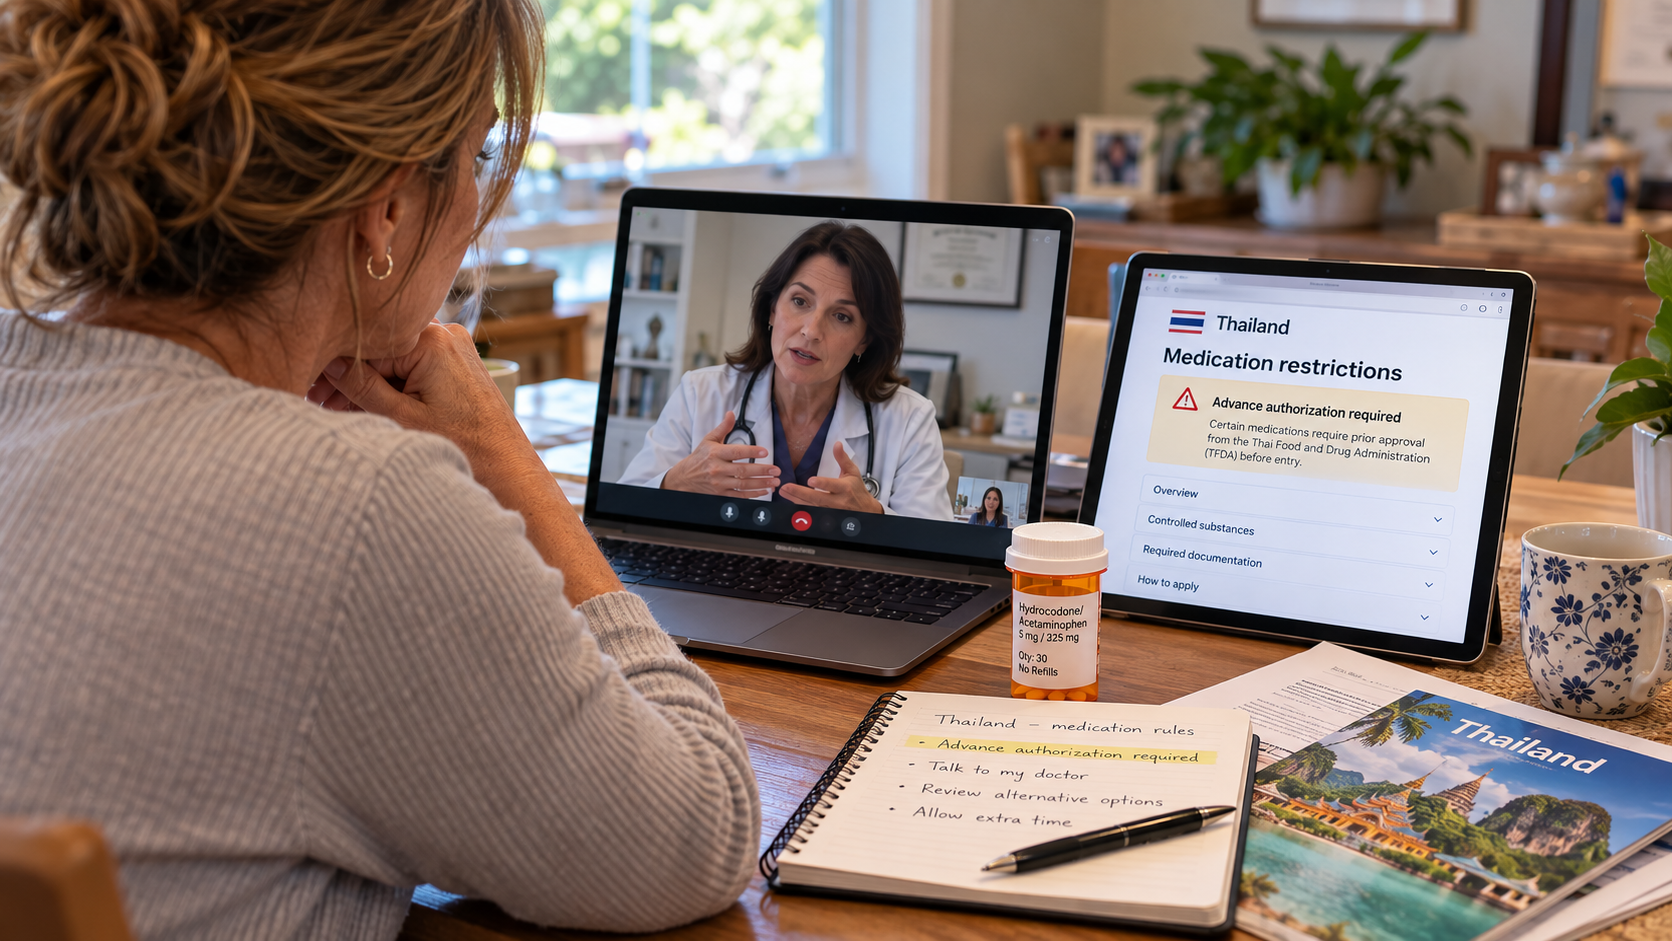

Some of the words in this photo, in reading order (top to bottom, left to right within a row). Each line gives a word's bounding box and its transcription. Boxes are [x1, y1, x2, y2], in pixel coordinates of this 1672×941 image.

[1216, 315, 1291, 336] Thailand
[1163, 348, 1274, 372] Medication
[1278, 359, 1403, 382] restrictions
[1211, 397, 1264, 412] Advance
[1265, 403, 1346, 419] authorization
[1348, 410, 1402, 424] required
[1209, 420, 1246, 432] Certain
[1247, 425, 1310, 438] medications
[1311, 431, 1349, 442] require
[1350, 433, 1377, 444] prior
[1379, 437, 1426, 449] approval
[1204, 448, 1238, 462] (TFDA)
[1240, 451, 1273, 463] before
[1275, 458, 1302, 468] entry.
[1207, 434, 1231, 445] from
[1232, 436, 1250, 447] the
[1252, 438, 1274, 449] Thai
[1275, 440, 1302, 452] Food
[1303, 444, 1324, 454] and
[1325, 445, 1352, 459] Drug
[1354, 448, 1430, 464] Administration
[1153, 485, 1199, 499] Overview
[1147, 515, 1198, 529] Controlled
[1199, 522, 1255, 536] substances
[1142, 545, 1187, 559] Required
[1188, 551, 1263, 568] documentation
[1137, 575, 1160, 586] How
[1160, 579, 1171, 588] to
[1172, 582, 1200, 593] apply
[1019, 602, 1084, 617] Hydrocodone/
[1019, 616, 1087, 631] Acetaminophen
[1025, 633, 1038, 643] mg
[1046, 633, 1063, 642] 325
[1065, 635, 1079, 643] mg
[1036, 653, 1048, 663] 30
[1018, 663, 1029, 673] No
[1031, 666, 1058, 676] Refills
[934, 715, 1017, 729] Thailand
[1051, 721, 1142, 733] medication
[1153, 725, 1195, 736] rules
[937, 739, 1005, 753] Advance
[1015, 746, 1123, 759] authorization
[1133, 753, 1199, 765] required
[1451, 718, 1608, 774] Thailand
[928, 762, 964, 773] Talk
[973, 765, 990, 775] to
[1000, 771, 1025, 783] my
[1034, 769, 1089, 780] doctor
[921, 784, 982, 797] Review
[994, 789, 1088, 804] alternative
[1100, 795, 1163, 809] options
[912, 806, 963, 820] Allow
[975, 813, 1021, 825] extra
[1032, 815, 1071, 828] time
